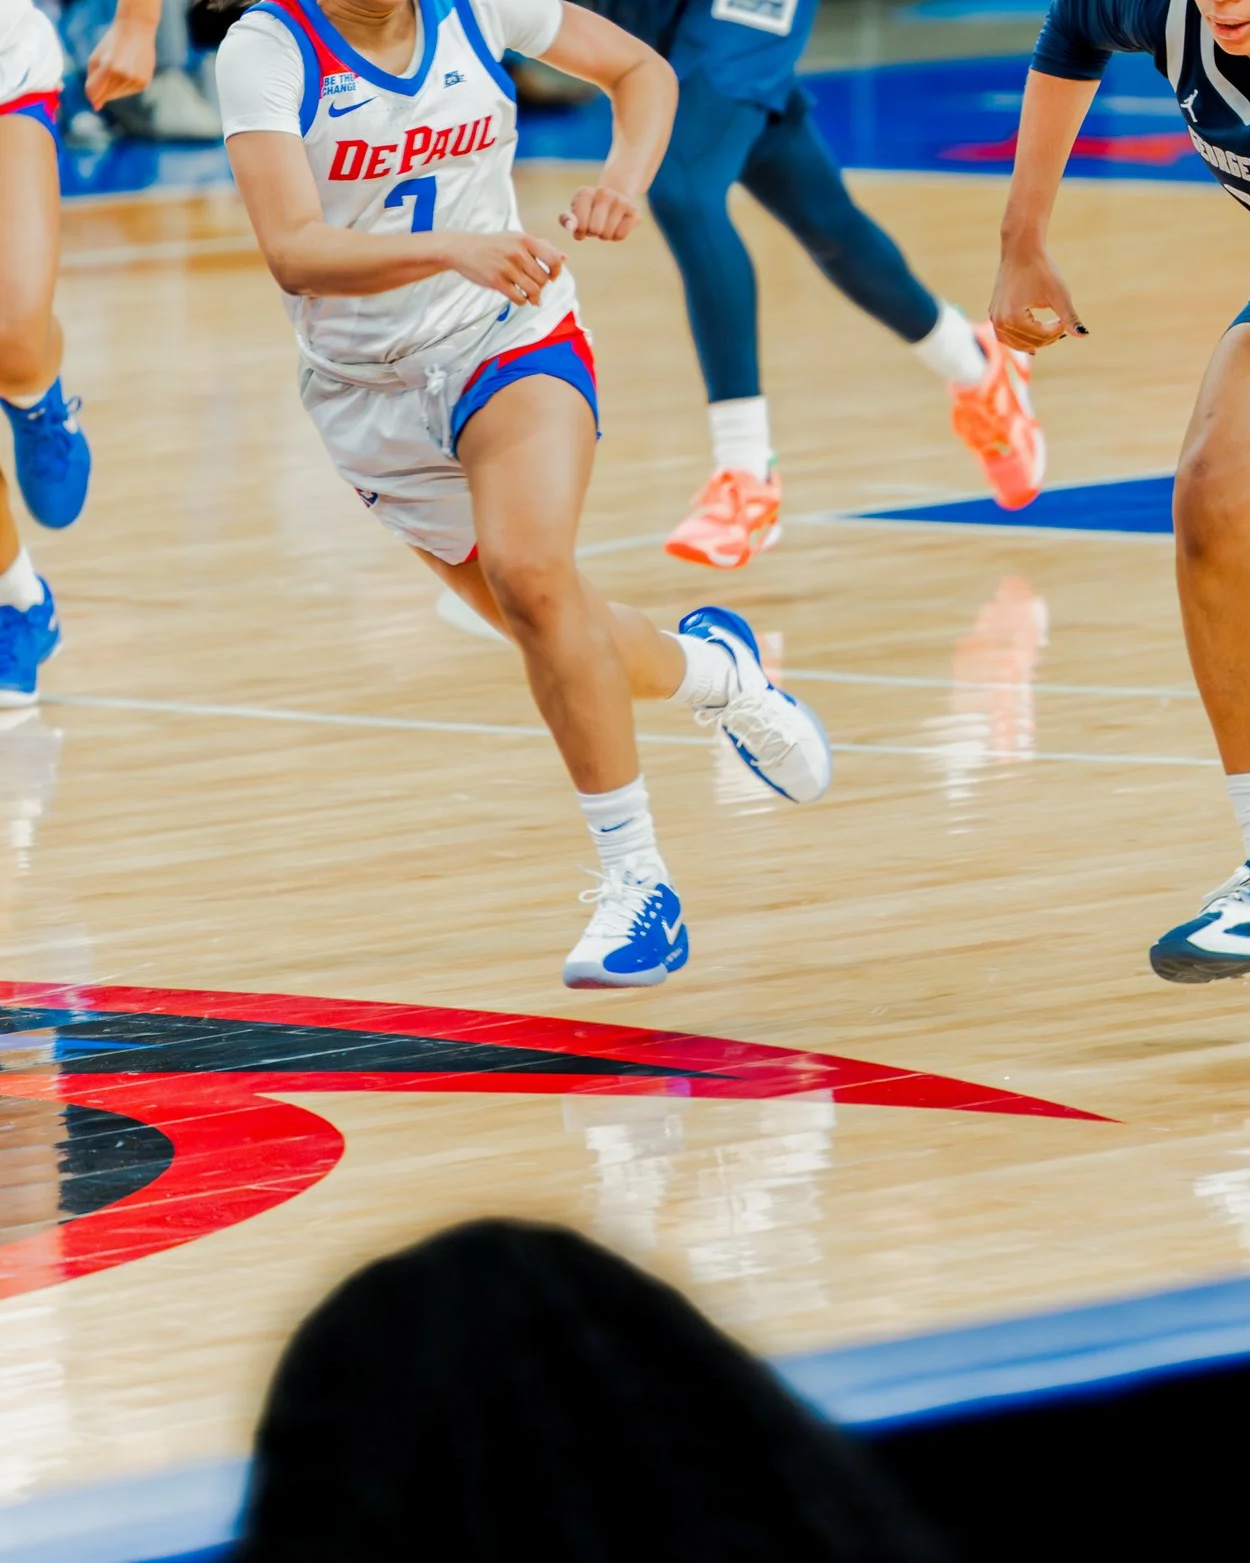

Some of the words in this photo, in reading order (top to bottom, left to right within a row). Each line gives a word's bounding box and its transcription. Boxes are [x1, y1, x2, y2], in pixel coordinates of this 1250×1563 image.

[324, 76, 336, 86] BE
[339, 72, 354, 83] THE
[322, 82, 356, 96] CHANGE
[384, 175, 437, 234] 7
